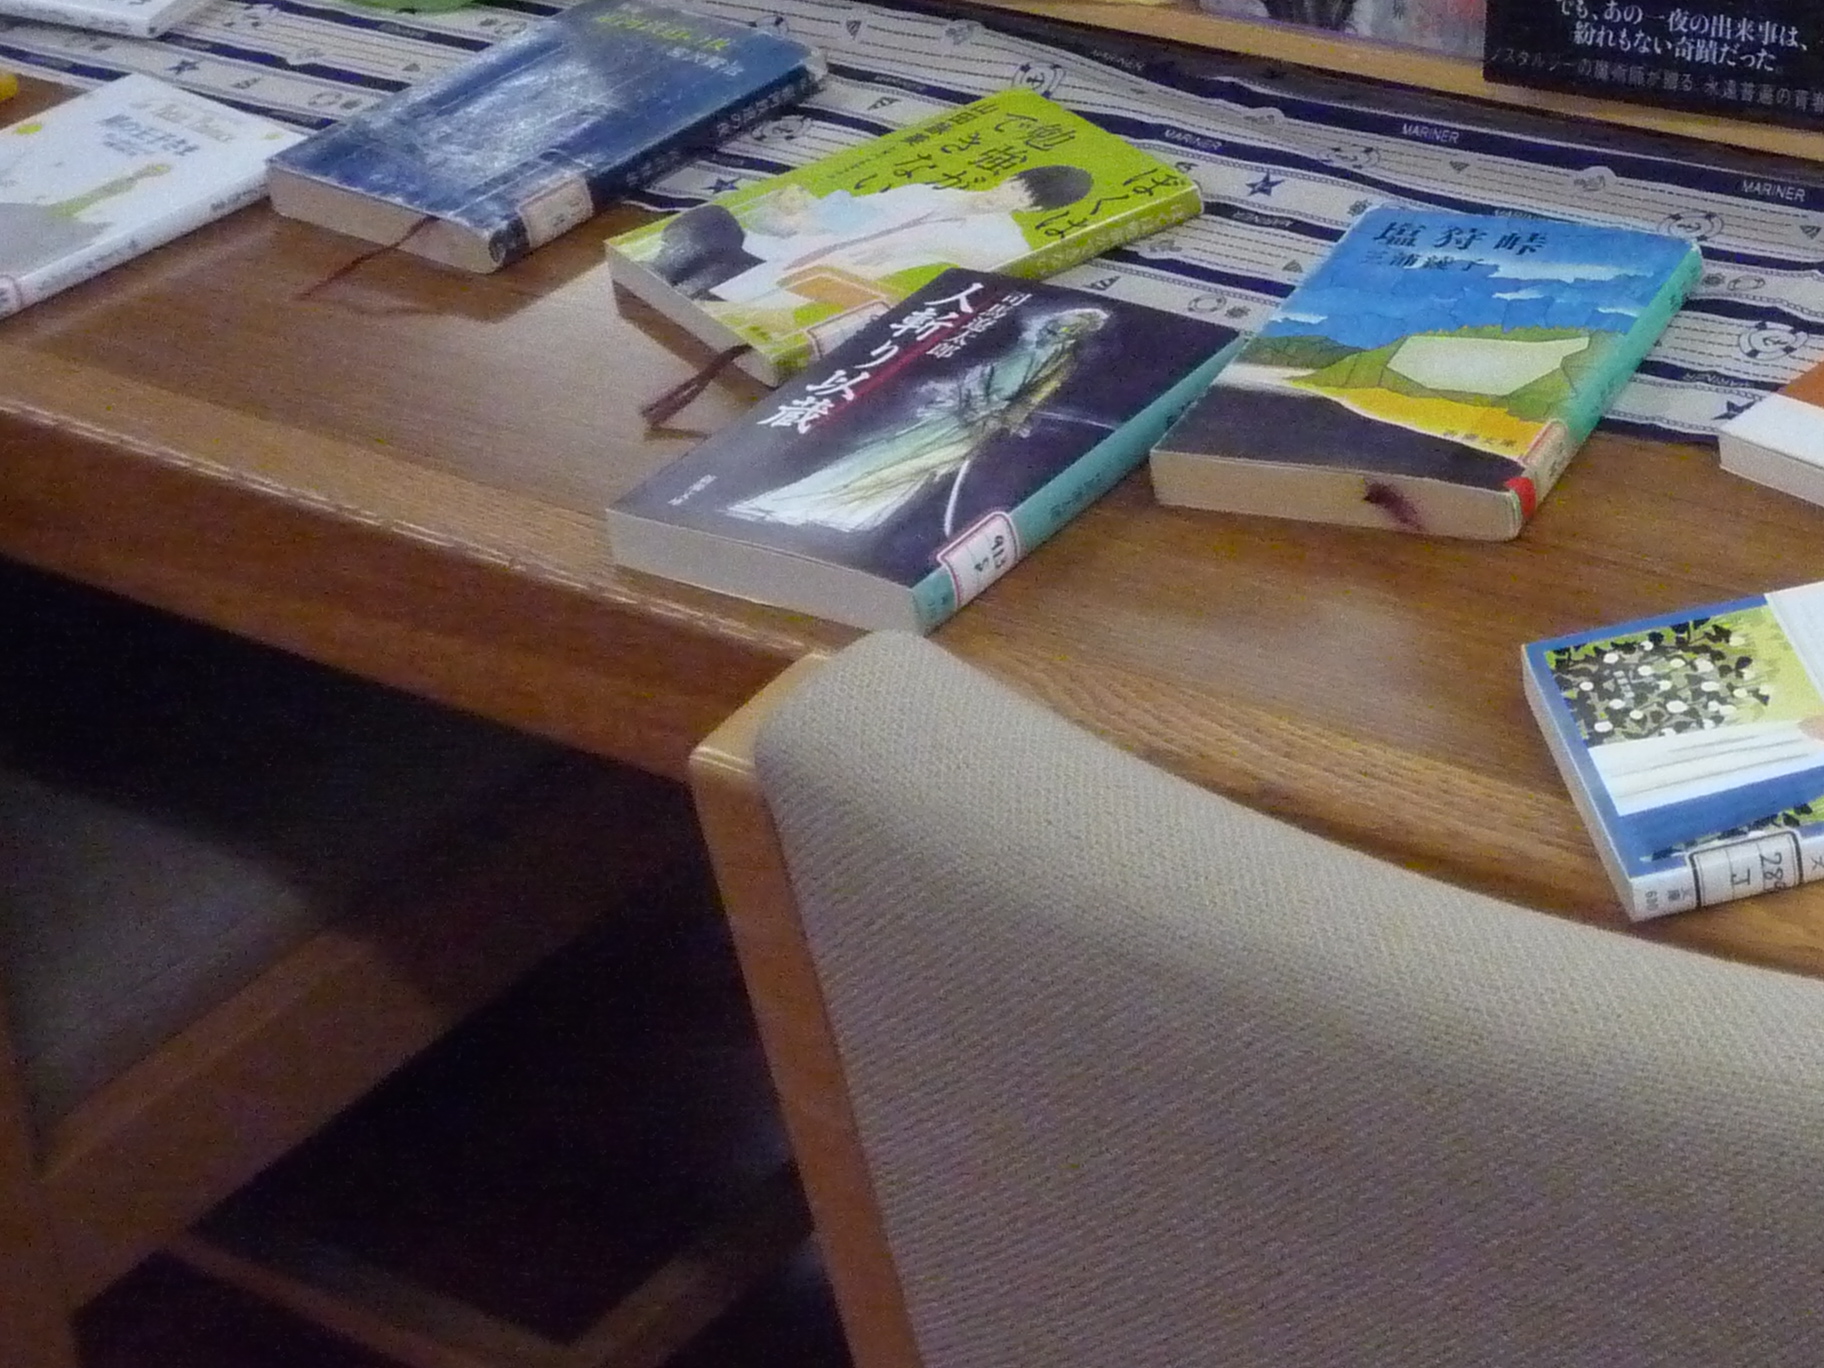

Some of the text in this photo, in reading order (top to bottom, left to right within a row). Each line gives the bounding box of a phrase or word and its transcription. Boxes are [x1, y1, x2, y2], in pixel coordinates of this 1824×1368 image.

[1165, 129, 1224, 152] MARINER
[1402, 123, 1460, 144] MARINER
[1741, 180, 1806, 203] MARINER
[1373, 221, 1548, 256] 塩狩峠
[755, 281, 986, 435] 人斬り以蔵
